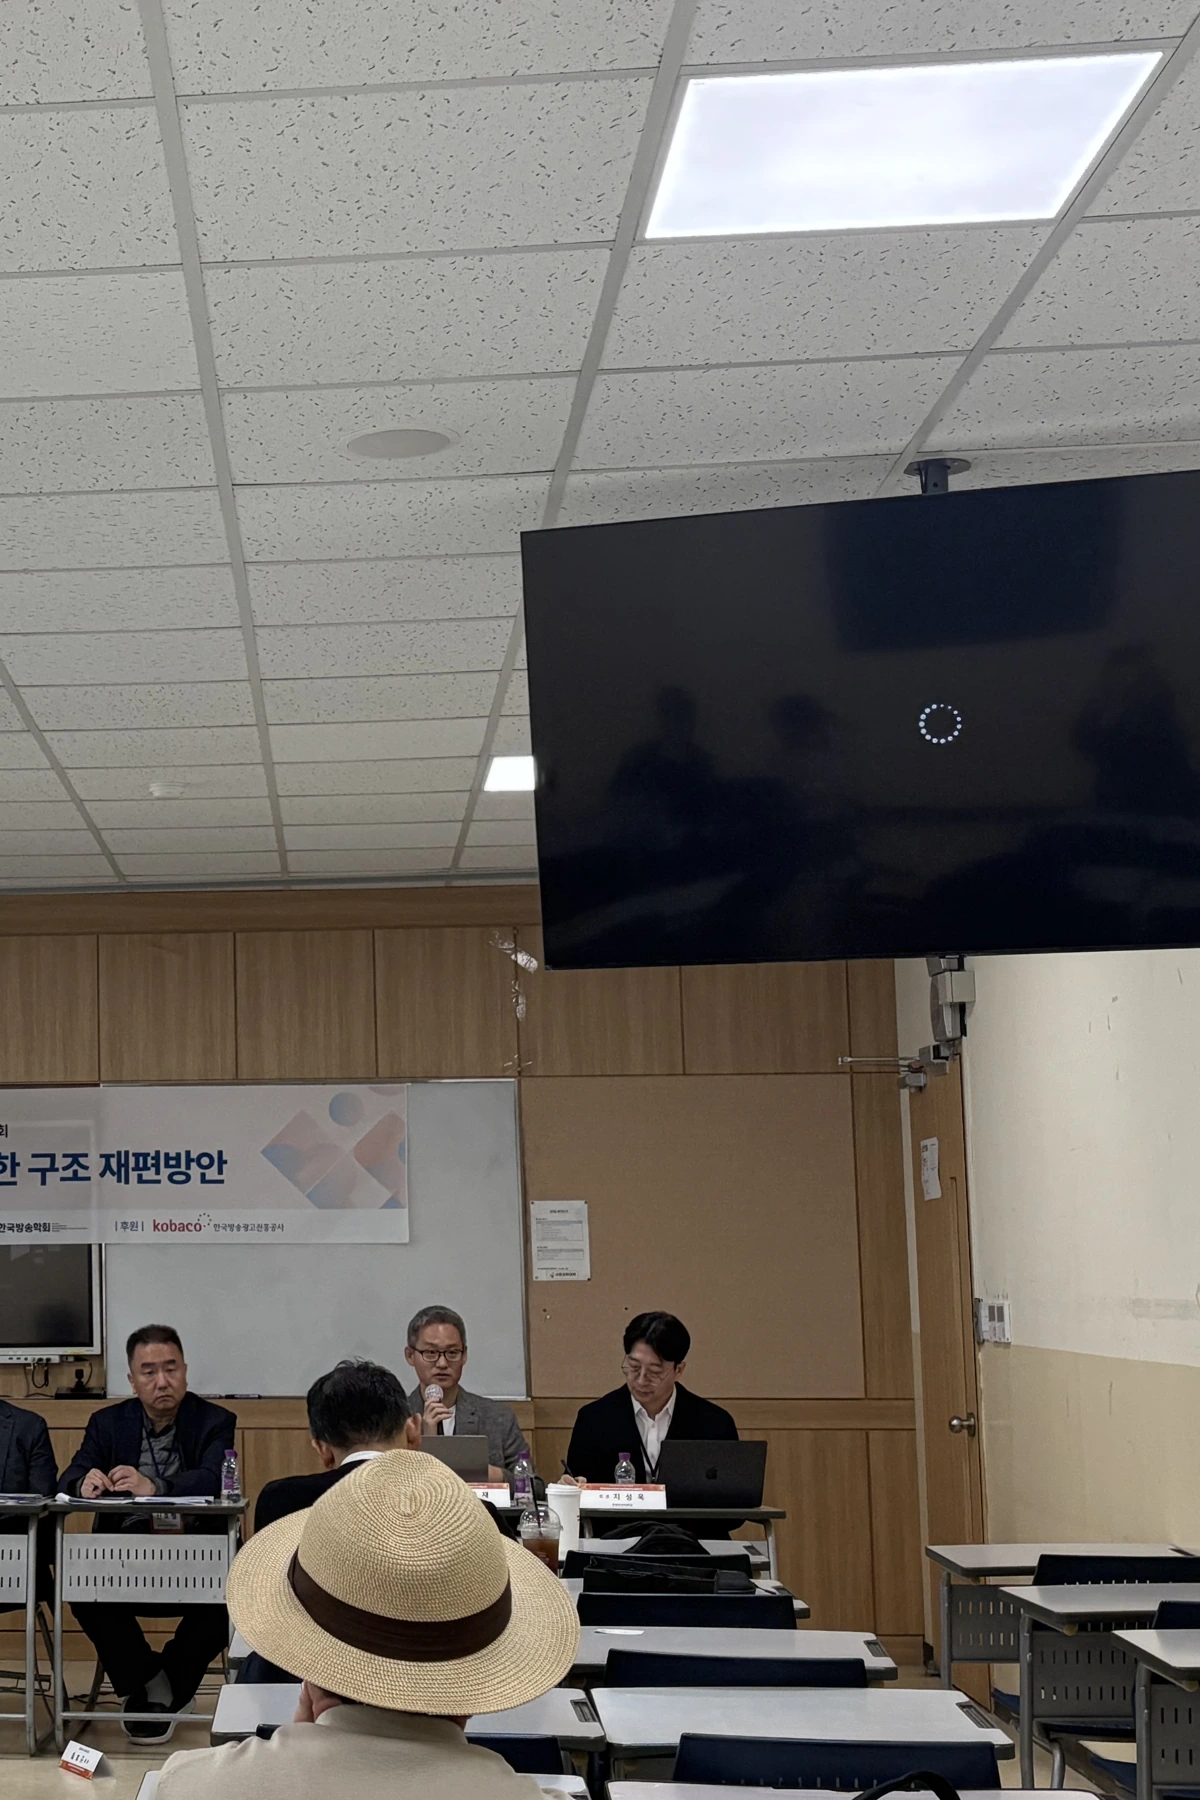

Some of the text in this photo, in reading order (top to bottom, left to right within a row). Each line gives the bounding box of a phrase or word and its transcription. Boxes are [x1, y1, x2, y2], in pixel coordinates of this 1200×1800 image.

[27, 1152, 91, 1186] 구조
[99, 1150, 227, 1185] 재편방안
[153, 1218, 202, 1233] kobaco
[213, 1223, 284, 1233] 한국방송광고진흥공사
